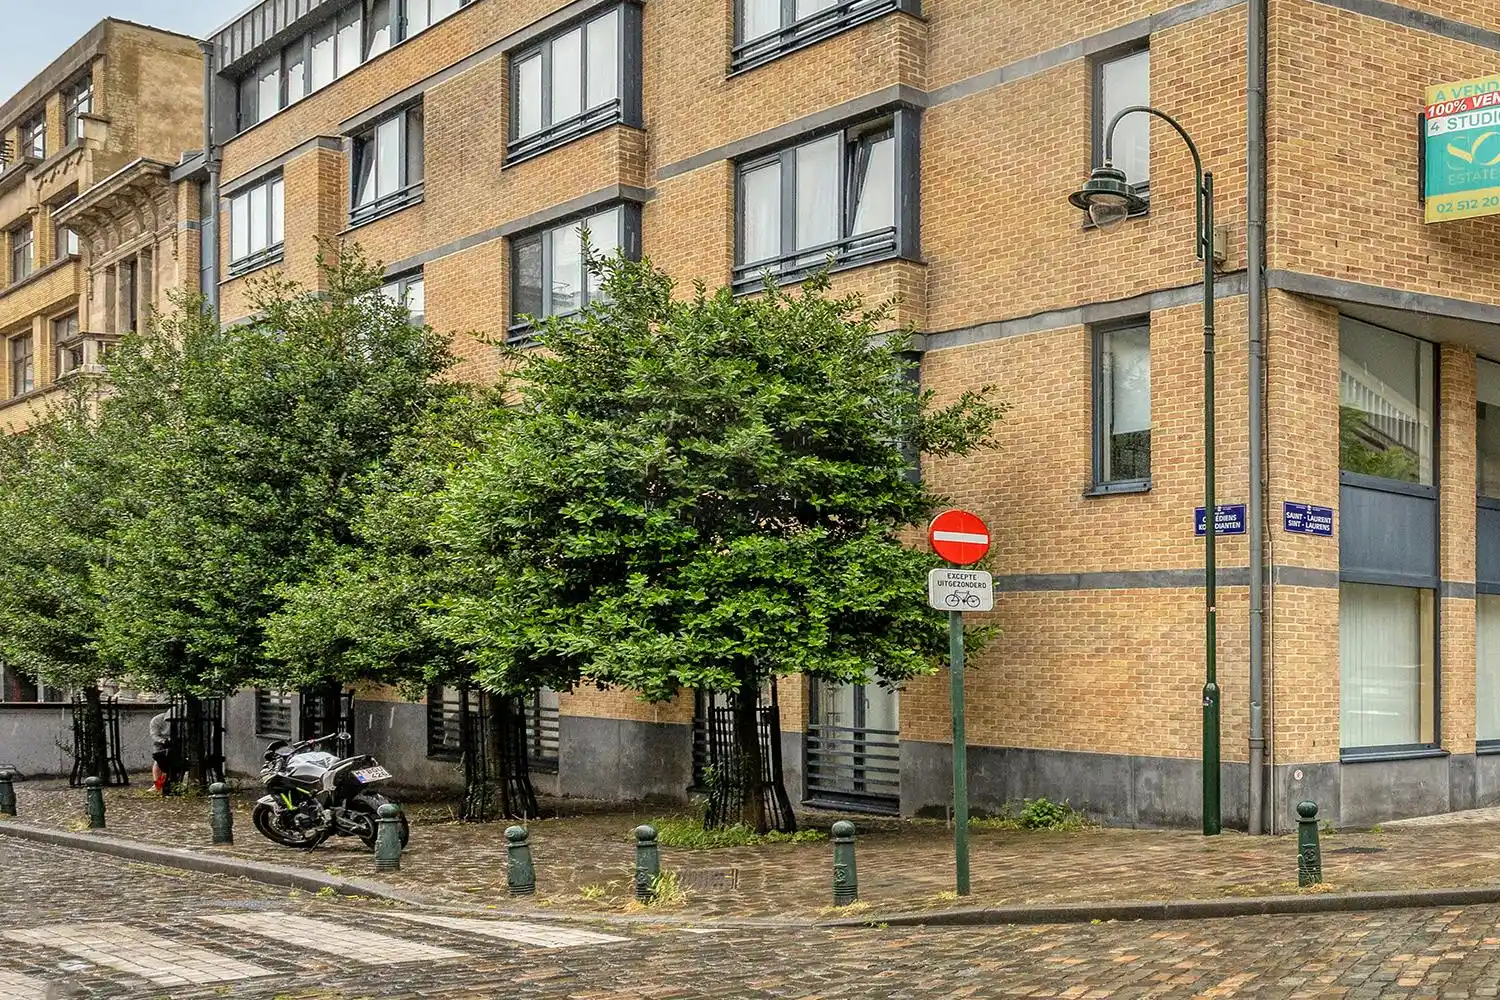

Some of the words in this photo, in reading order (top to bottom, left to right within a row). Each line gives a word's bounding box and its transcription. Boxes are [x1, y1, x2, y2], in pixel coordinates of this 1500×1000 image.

[1435, 90, 1446, 102] A
[1428, 99, 1467, 117] 100%
[1430, 121, 1440, 131] 4
[1436, 202, 1453, 213] 02
[1457, 199, 1478, 211] 512
[1482, 196, 1499, 207] 20
[1286, 512, 1303, 520] SAINT
[1307, 515, 1331, 523] LAURENT
[1198, 522, 1241, 531] KODIANTEN
[1305, 522, 1330, 531] LAURENS
[937, 580, 987, 589] UITGEZONDERD
